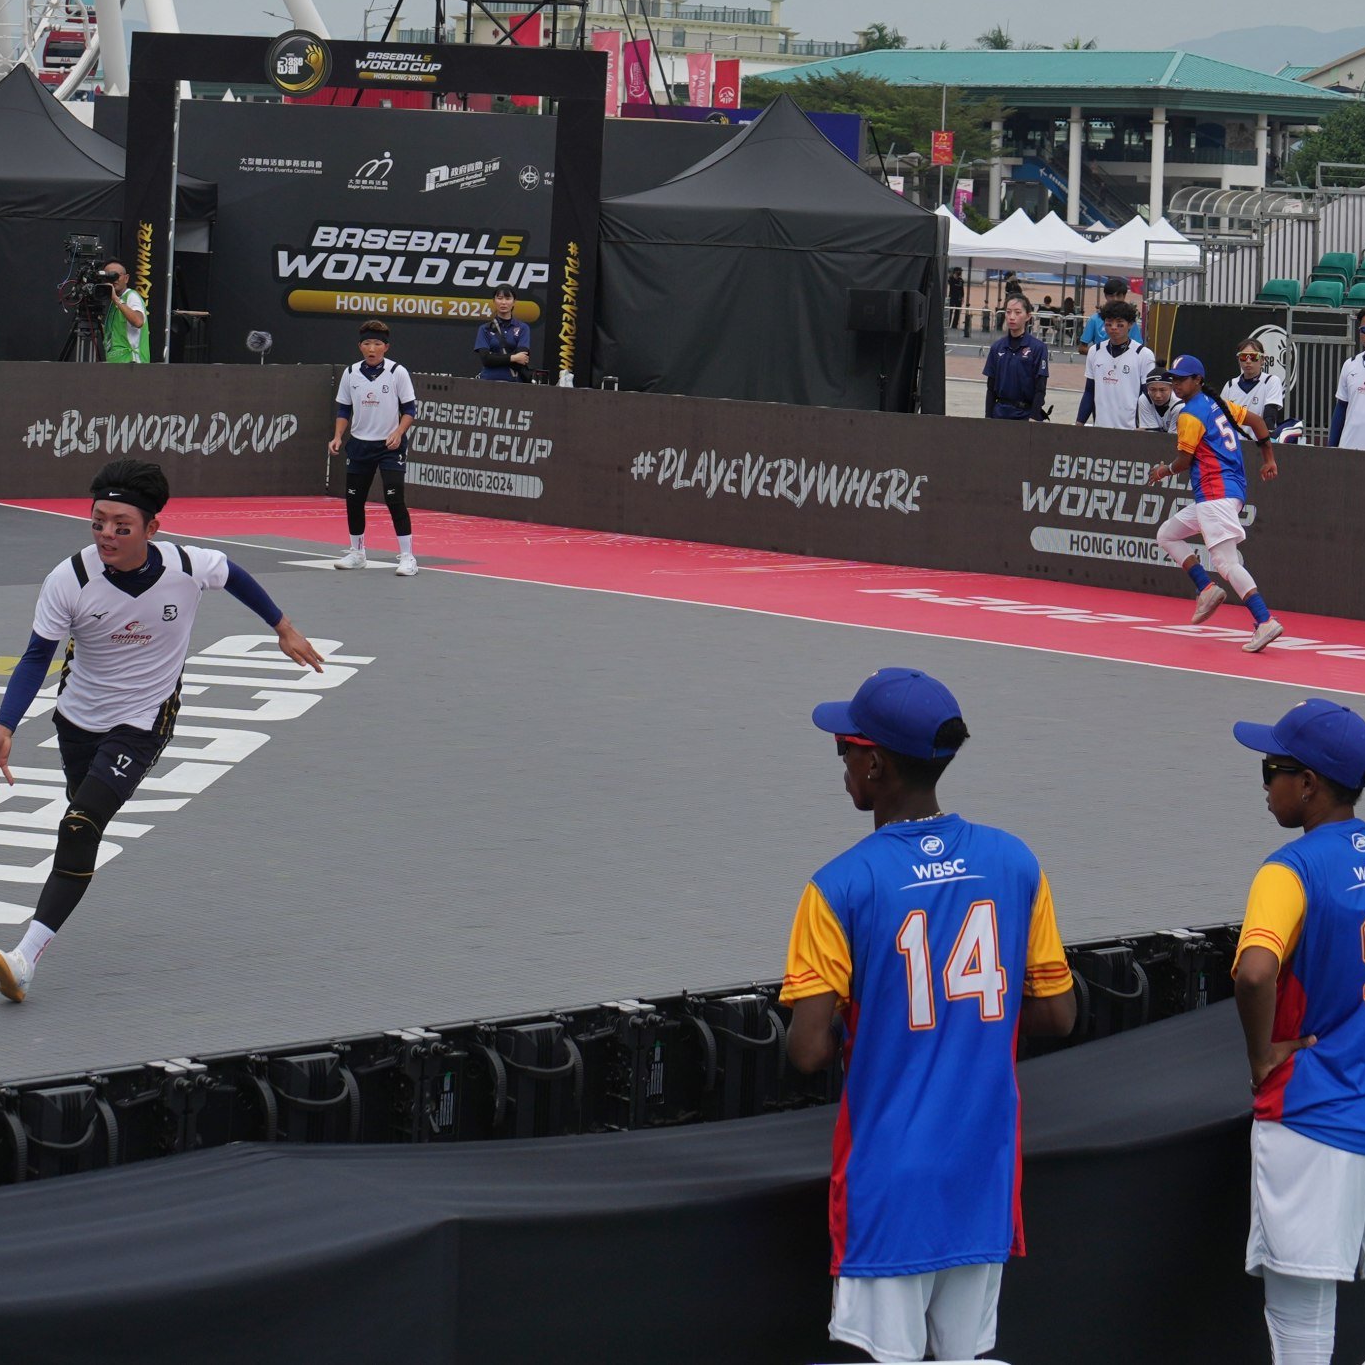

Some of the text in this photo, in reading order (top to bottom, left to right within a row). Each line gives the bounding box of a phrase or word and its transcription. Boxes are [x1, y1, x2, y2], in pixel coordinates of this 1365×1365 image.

[355, 59, 442, 73] WORLD CUP
[366, 51, 432, 63] BASEBALL5
[311, 226, 524, 256] BASEBALL5
[278, 250, 550, 290] WORLD CUP
[335, 294, 492, 317] HONG KONG 2024
[1215, 414, 1238, 452] 5
[489, 434, 554, 465] CUP
[419, 467, 514, 492] HONG KONG 2024
[630, 446, 929, 515] #PLAYEVERYWHERE
[1021, 480, 1166, 525] WORLD
[1068, 532, 1113, 556] HONG
[1116, 538, 1159, 562] KONG
[115, 752, 134, 770] 17
[911, 858, 967, 880] WBSC
[895, 899, 1009, 1032] 14
